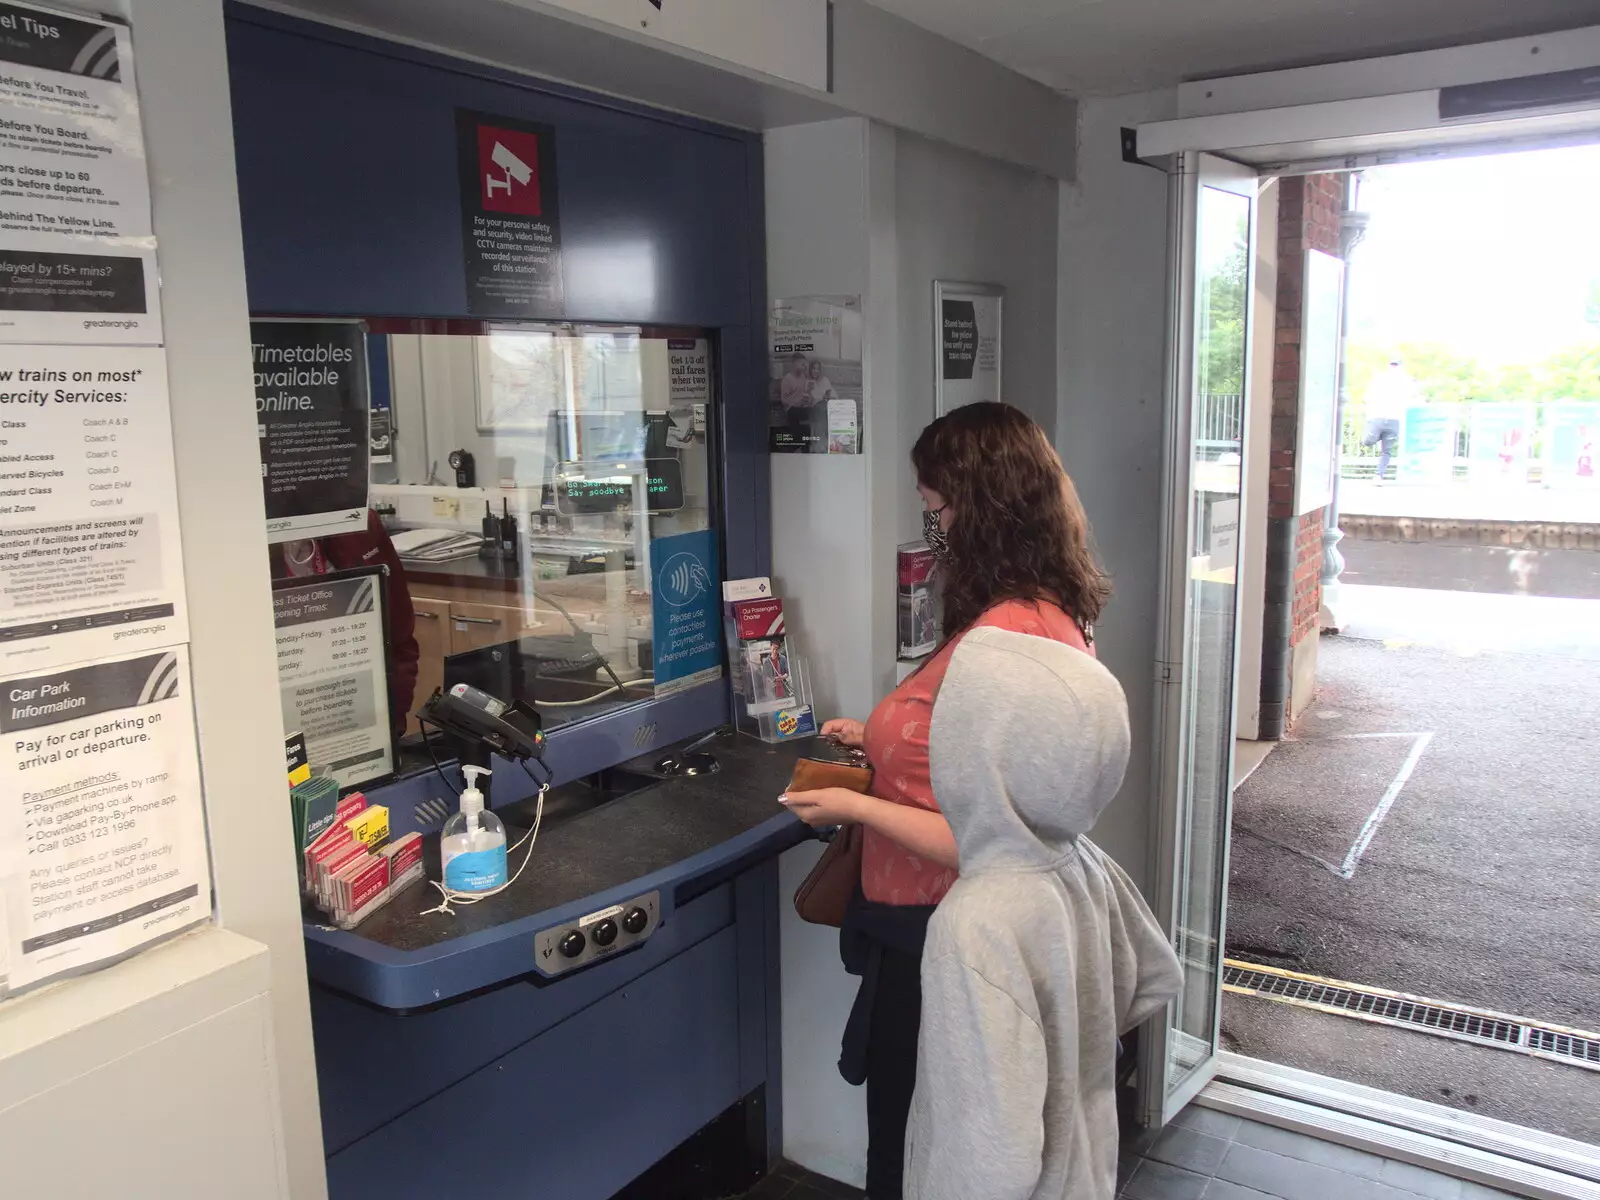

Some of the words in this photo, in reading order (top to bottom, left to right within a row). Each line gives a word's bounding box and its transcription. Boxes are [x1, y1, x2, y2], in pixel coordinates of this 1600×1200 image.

[20, 17, 60, 39] Tips
[34, 82, 54, 93] You
[56, 85, 90, 100] Travel.
[34, 124, 54, 136] You
[57, 128, 90, 140] Board.
[41, 138, 62, 147] tickets
[64, 140, 84, 149] before
[18, 165, 47, 177] close
[50, 170, 63, 181] up
[66, 170, 76, 180] to
[17, 178, 51, 190] before
[53, 183, 105, 196] departure.
[36, 213, 56, 224] The
[57, 216, 90, 228] Yellow
[92, 218, 116, 229] Line.
[474, 216, 485, 225] For
[486, 218, 502, 228] your
[503, 220, 530, 230] personal
[531, 223, 551, 233] safety
[473, 228, 486, 237] and
[488, 230, 514, 241] security,
[515, 232, 533, 241] video
[534, 233, 553, 242] linked
[476, 239, 496, 248] CCTV
[496, 242, 522, 252] cameras
[524, 244, 550, 253] maintain
[481, 252, 510, 261] recorded
[512, 254, 548, 264] surveillance
[38, 263, 52, 276] by
[56, 264, 78, 276] 15+
[80, 266, 114, 278] mins?
[493, 263, 500, 272] of
[501, 263, 514, 272] this
[514, 264, 538, 274] station.
[35, 277, 84, 287] compensation
[83, 320, 139, 330] greateranglia
[251, 342, 352, 362] Timetables
[671, 356, 684, 364] Get
[696, 356, 706, 364] off
[19, 368, 68, 382] trains
[72, 371, 92, 382] on
[253, 366, 339, 387] available
[672, 366, 685, 374] rail
[686, 366, 706, 375] fares
[672, 376, 692, 384] when
[692, 376, 706, 384] two
[54, 389, 128, 404] Services:
[256, 391, 314, 412] online.
[1, 420, 26, 429] Class
[82, 418, 108, 427] Coach
[84, 434, 108, 443] Coach
[24, 453, 54, 462] Access
[86, 450, 110, 459] Coach
[28, 470, 64, 480] Bicycles
[28, 487, 52, 496] Class
[568, 488, 583, 497] Say
[588, 487, 624, 497] goodbye
[14, 504, 36, 514] Zone
[0, 525, 73, 538] Announcements
[75, 522, 92, 532] and
[94, 520, 128, 530] screens
[129, 516, 144, 526] will
[82, 532, 96, 541] are
[97, 530, 128, 540] altered
[22, 548, 62, 559] different
[62, 544, 88, 556] types
[100, 541, 128, 550] trains:
[286, 594, 310, 605] Ticket
[310, 590, 333, 600] Office
[670, 612, 692, 624] Please
[692, 609, 704, 618] use
[668, 621, 706, 637] contactless
[672, 633, 704, 650] payments
[659, 649, 689, 665] wherever
[9, 689, 38, 702] Car
[40, 681, 72, 698] Park
[296, 686, 316, 696] Allow
[316, 681, 342, 694] enough
[304, 693, 335, 706] purchase
[336, 688, 358, 698] tickets
[11, 696, 86, 720] Information
[300, 705, 322, 716] before
[15, 738, 42, 754] Pay
[46, 734, 66, 747] for
[70, 728, 91, 741] car
[94, 716, 145, 737] parking
[148, 712, 162, 724] on
[18, 750, 62, 771] arrival
[65, 747, 80, 760] or
[82, 732, 152, 755] departure.
[22, 782, 72, 804] Payment
[73, 770, 120, 790] methods:
[33, 795, 80, 814] Payment
[81, 783, 130, 801] machines
[131, 780, 144, 790] by
[146, 772, 169, 786] ramp
[34, 816, 54, 828] Via
[56, 794, 134, 824] gaparking.co.uk
[35, 820, 88, 841] Download
[90, 799, 161, 825] Pay-By-Phone
[322, 814, 334, 825] tips
[36, 840, 60, 854] Call
[62, 831, 87, 848] 0333
[90, 826, 110, 840] 123
[112, 819, 136, 835] 1996
[29, 866, 52, 880] Any
[55, 854, 96, 875] queries
[30, 874, 72, 893] Please
[74, 864, 113, 882] contact
[114, 854, 138, 869] NCP
[140, 843, 174, 862] directly
[32, 888, 72, 908] Station
[101, 869, 135, 888] cannot
[136, 862, 158, 876] take
[32, 901, 84, 922] payment
[100, 884, 134, 901] access
